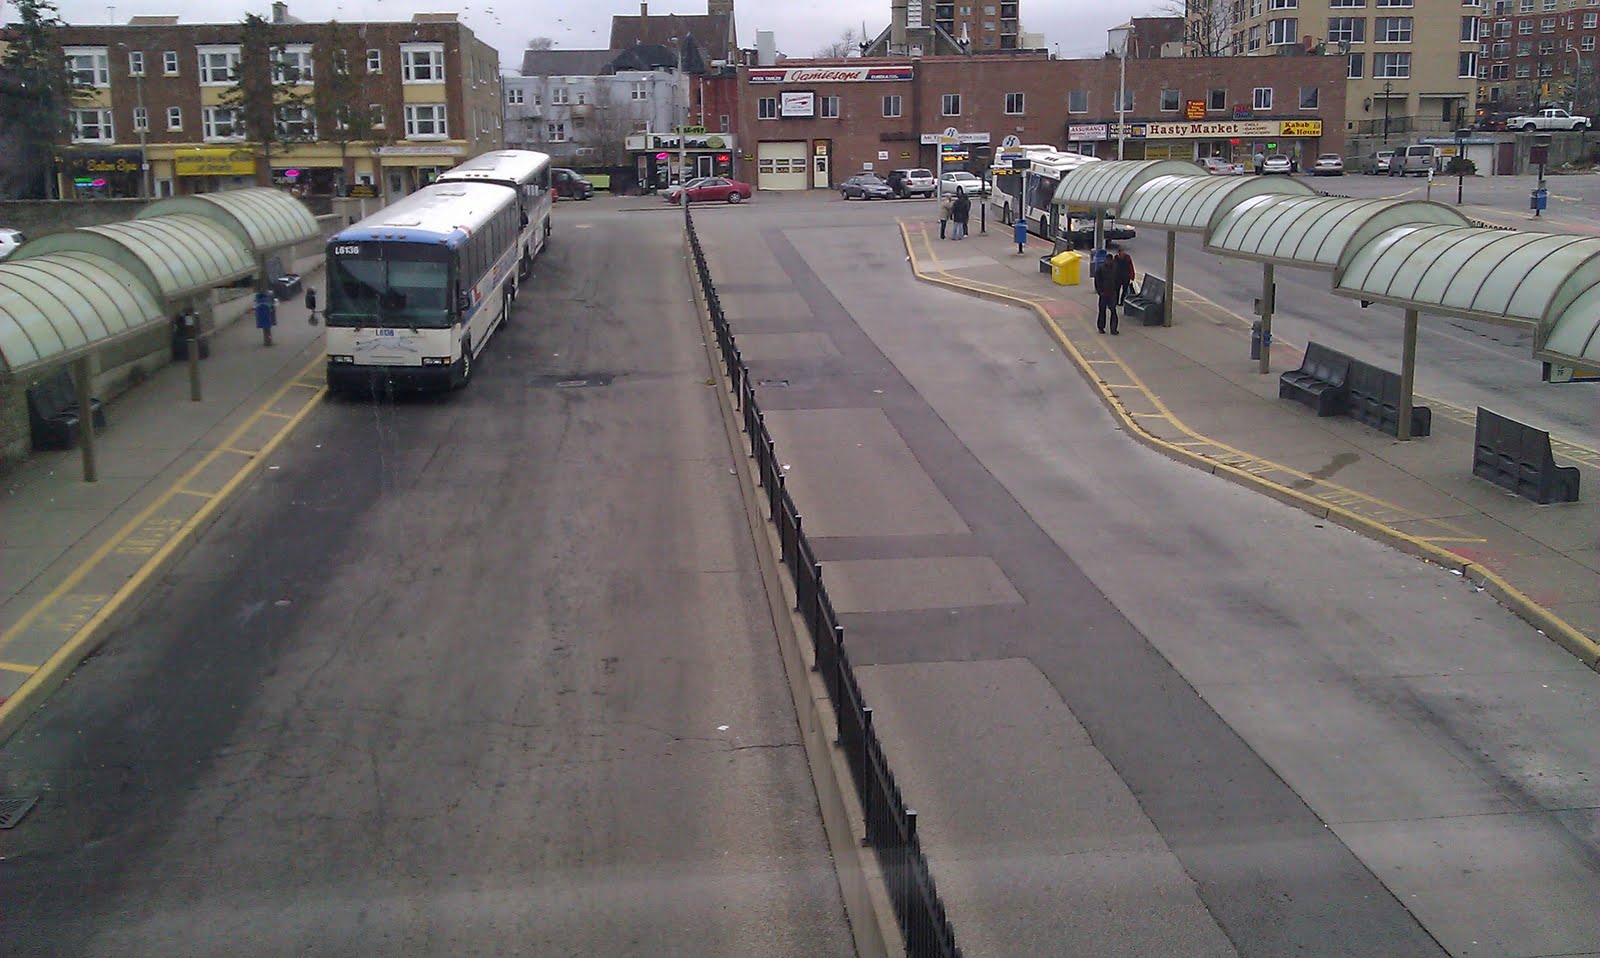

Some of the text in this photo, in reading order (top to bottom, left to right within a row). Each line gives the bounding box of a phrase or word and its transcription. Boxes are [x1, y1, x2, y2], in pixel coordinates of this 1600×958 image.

[1150, 124, 1239, 136] Hasty Market
[335, 246, 360, 255] L6136
